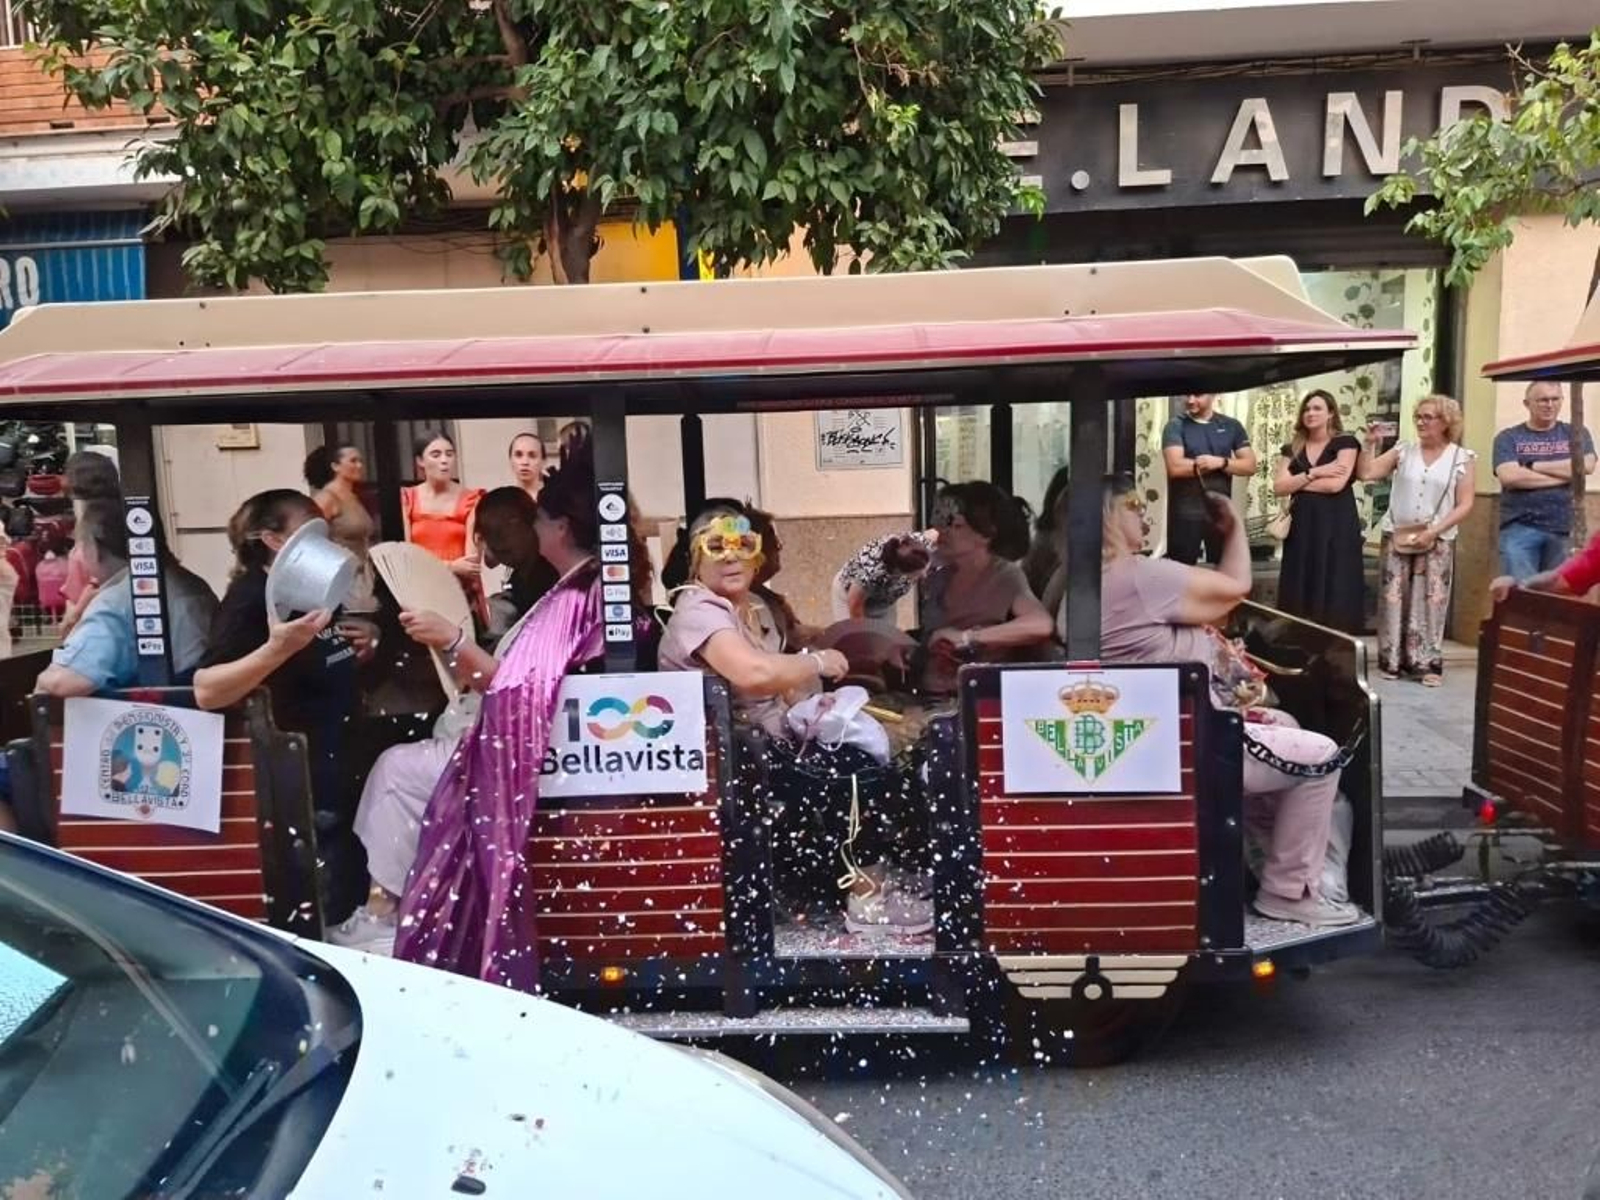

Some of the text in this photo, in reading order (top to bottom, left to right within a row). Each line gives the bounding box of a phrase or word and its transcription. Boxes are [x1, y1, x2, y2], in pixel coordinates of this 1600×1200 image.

[604, 549, 626, 557] VISA
[133, 562, 155, 571] VISA
[614, 627, 630, 638] Pay
[539, 744, 704, 775] Bellavista
[112, 795, 178, 807] BELLAVISTA
